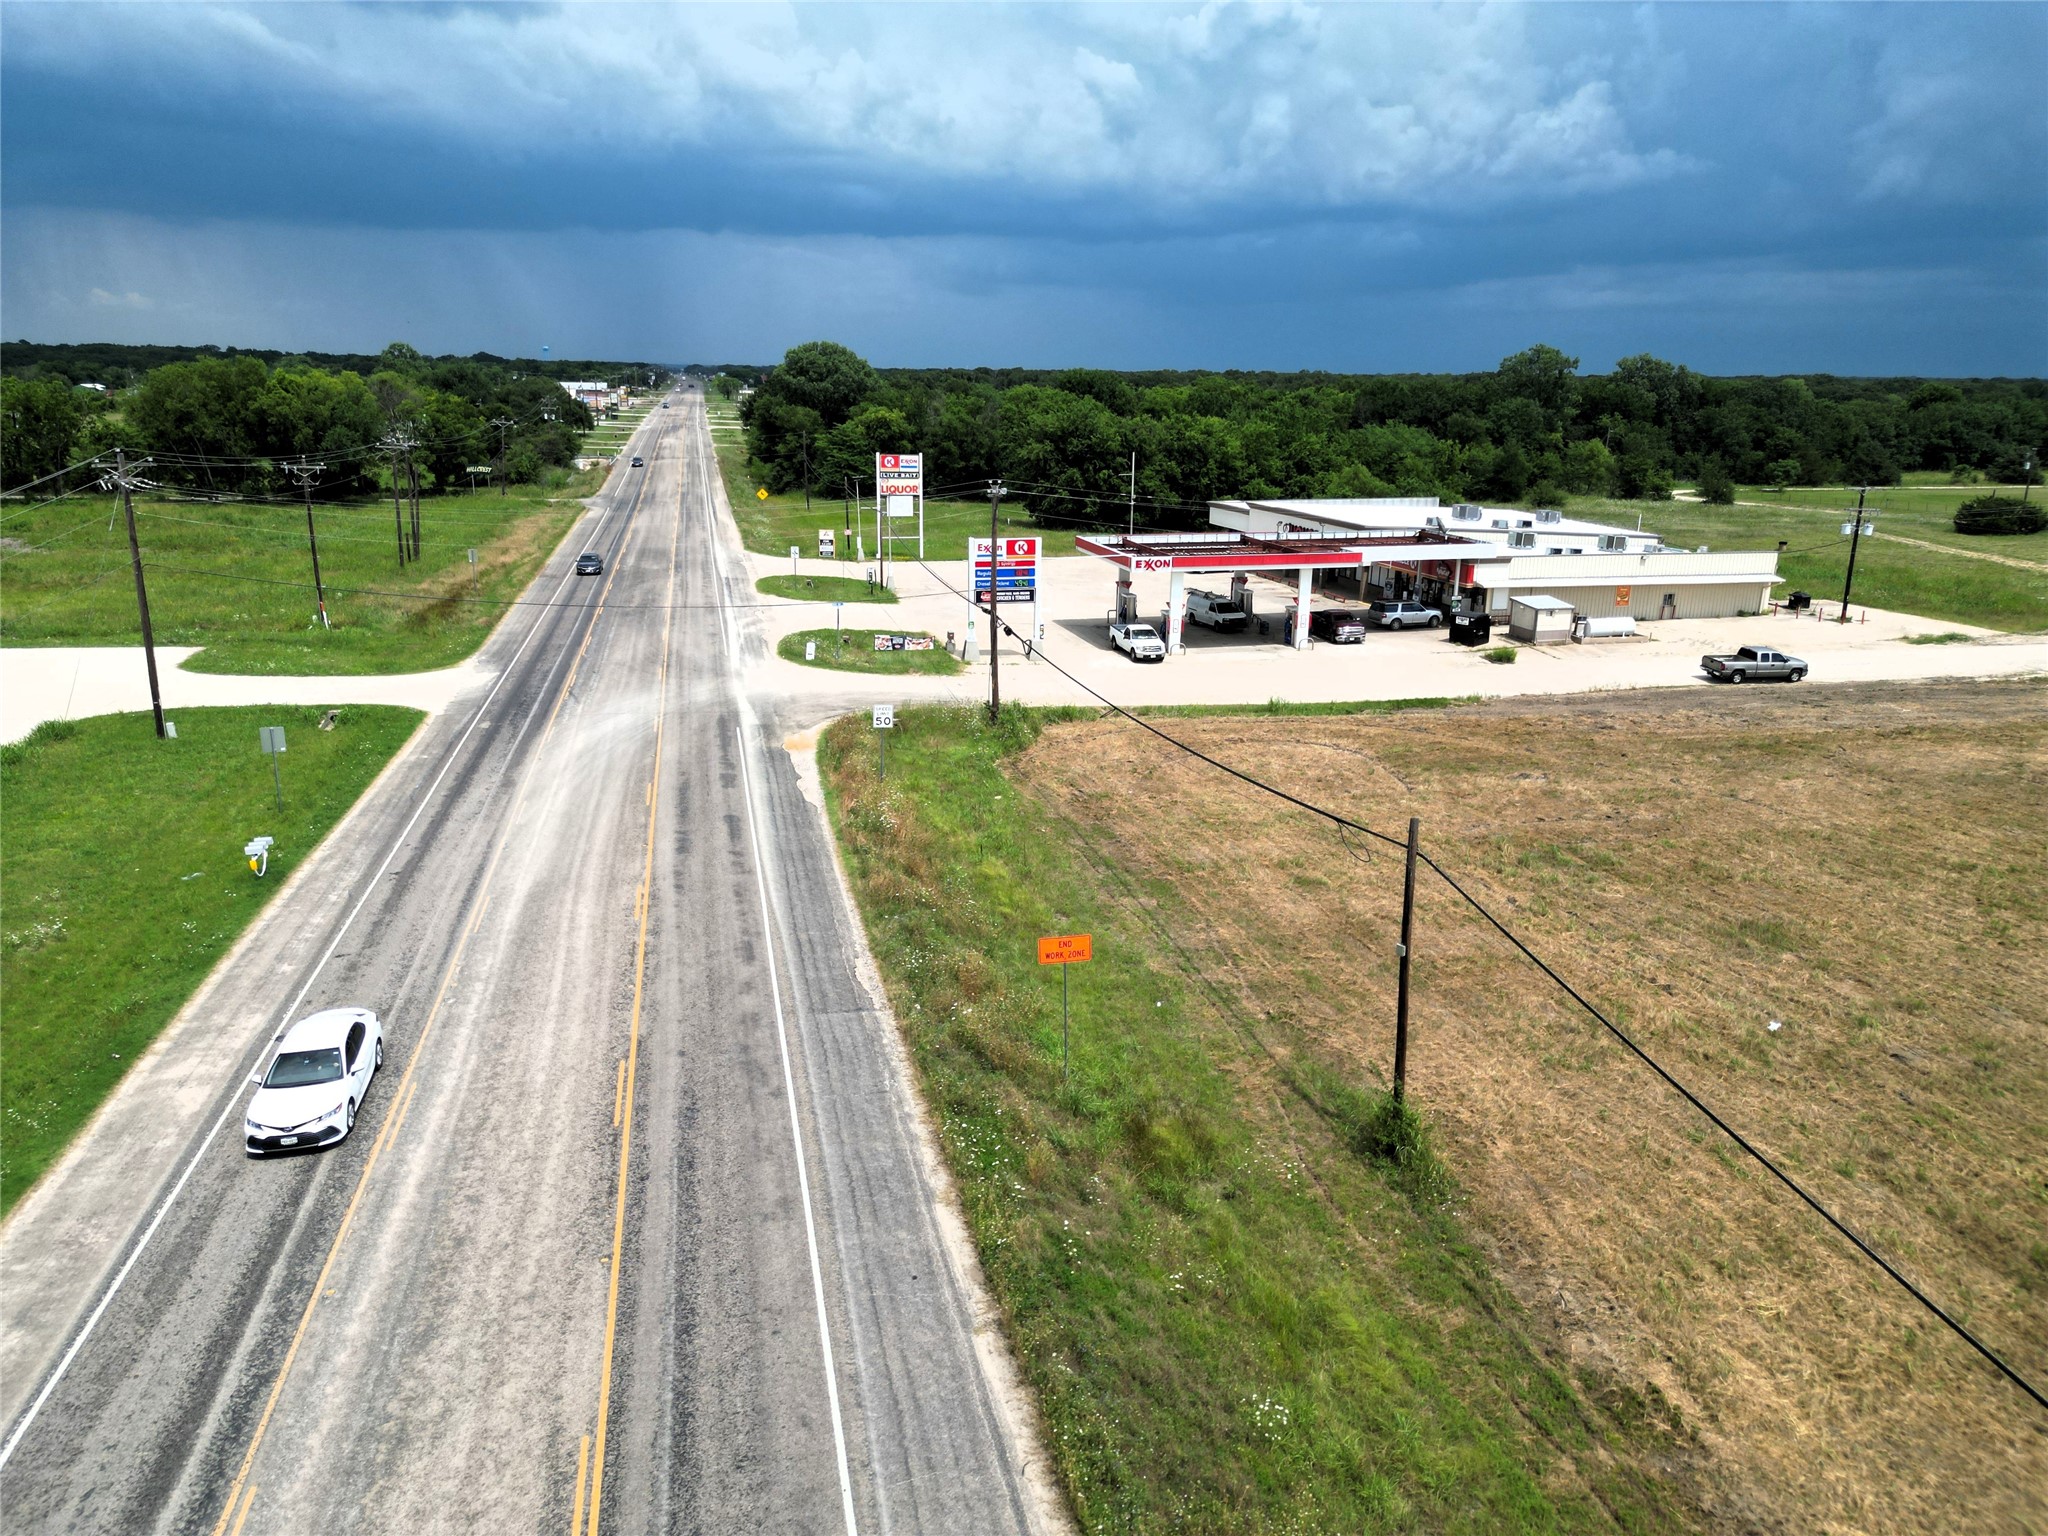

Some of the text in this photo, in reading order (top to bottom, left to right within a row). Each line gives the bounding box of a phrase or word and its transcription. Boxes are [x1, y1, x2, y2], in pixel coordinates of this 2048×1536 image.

[886, 458, 894, 467] K
[881, 485, 918, 494] LIQUOR
[977, 543, 1003, 553] Exxn
[1018, 543, 1027, 553] K
[1135, 558, 1170, 571] EXXON
[876, 716, 891, 725] 50
[1058, 940, 1072, 948] END
[1045, 949, 1086, 960] WORK ZONE
